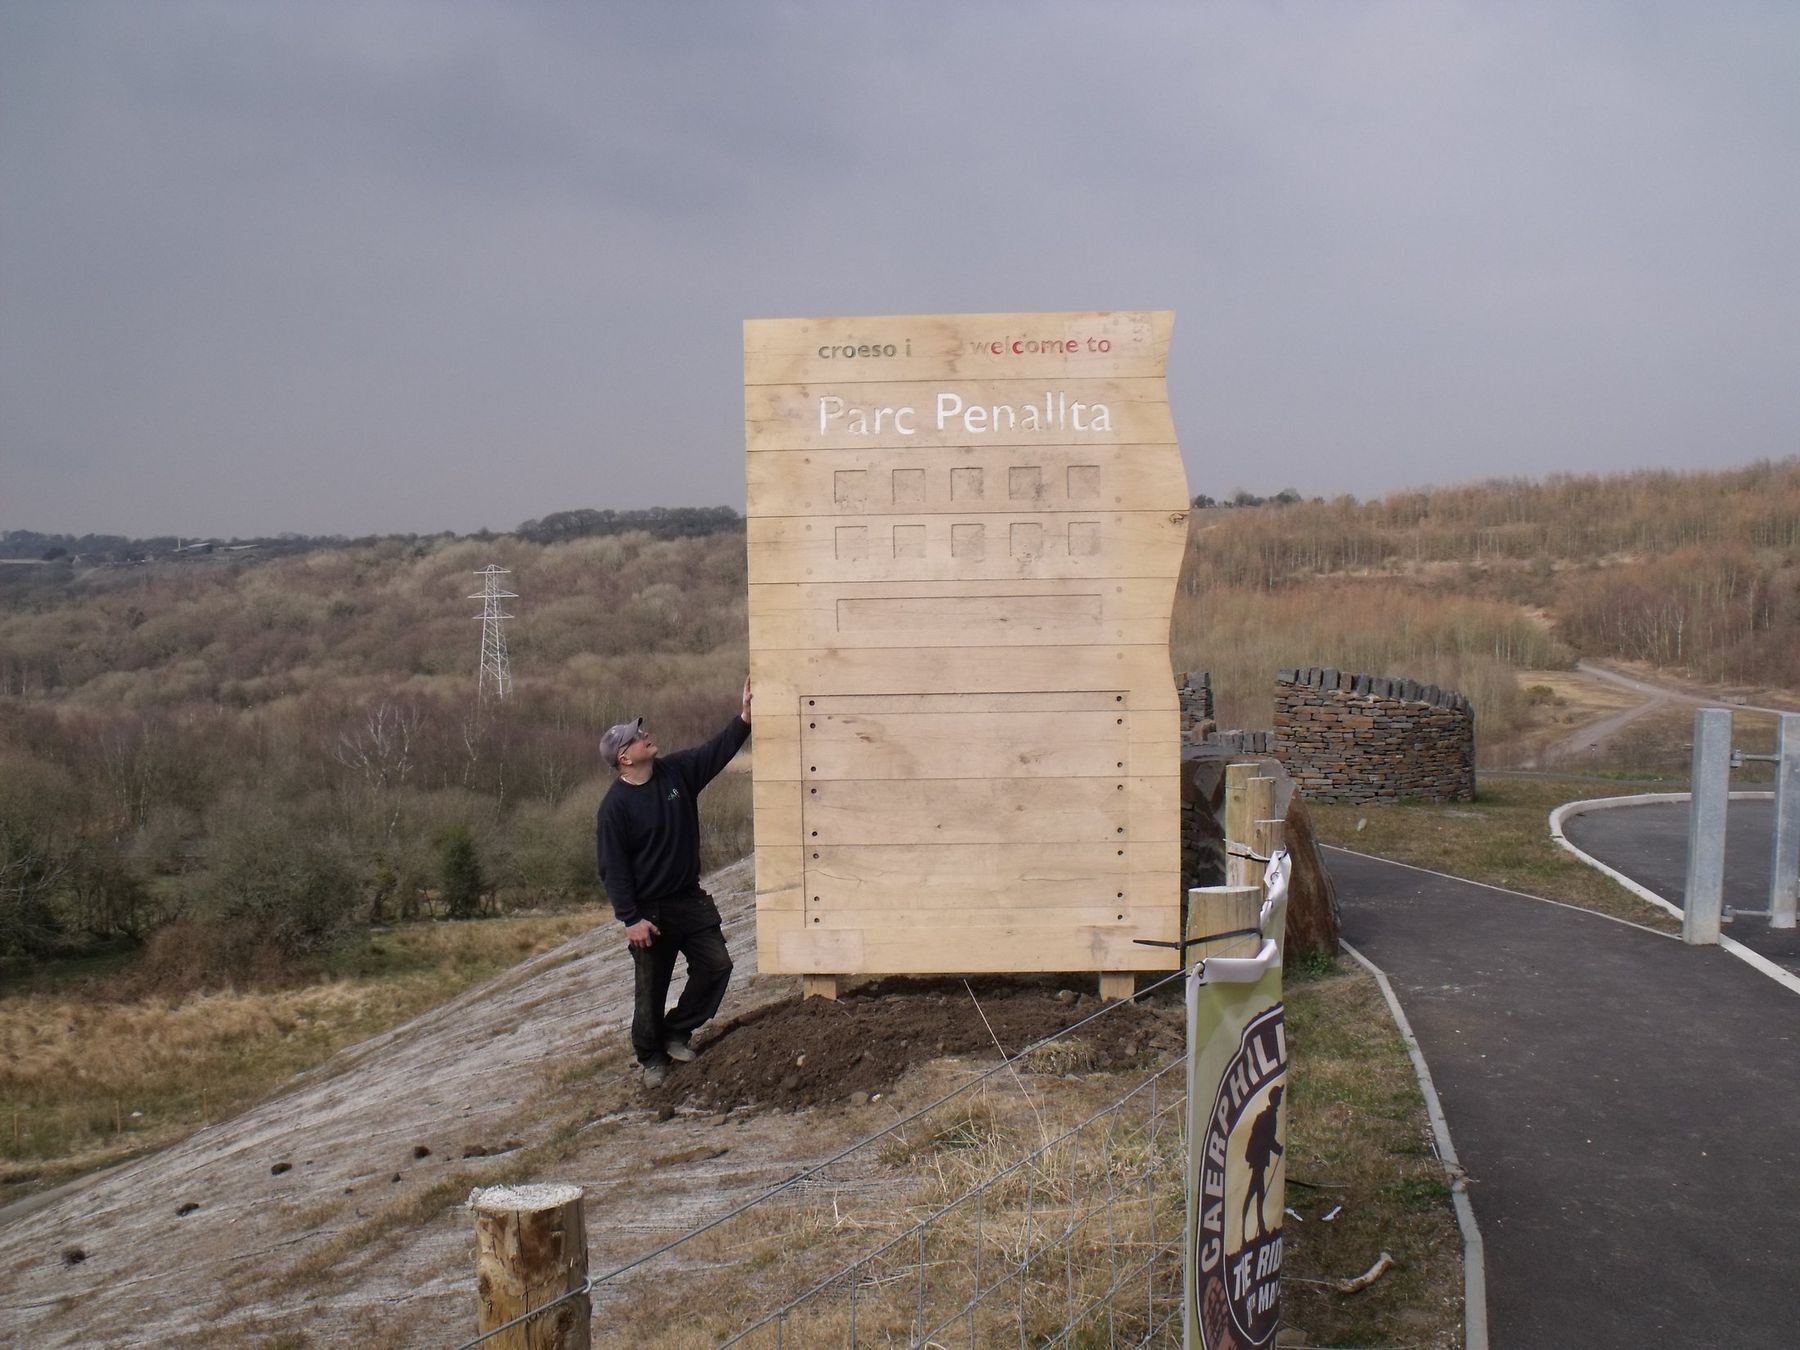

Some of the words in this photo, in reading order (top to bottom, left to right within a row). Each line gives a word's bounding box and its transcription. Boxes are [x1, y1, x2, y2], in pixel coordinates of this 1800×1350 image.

[818, 343, 897, 359] croeso
[905, 338, 912, 357] i
[969, 335, 1079, 355] welcome
[1087, 336, 1111, 353] to
[818, 395, 916, 436] Parc
[936, 391, 1113, 433] Penallta
